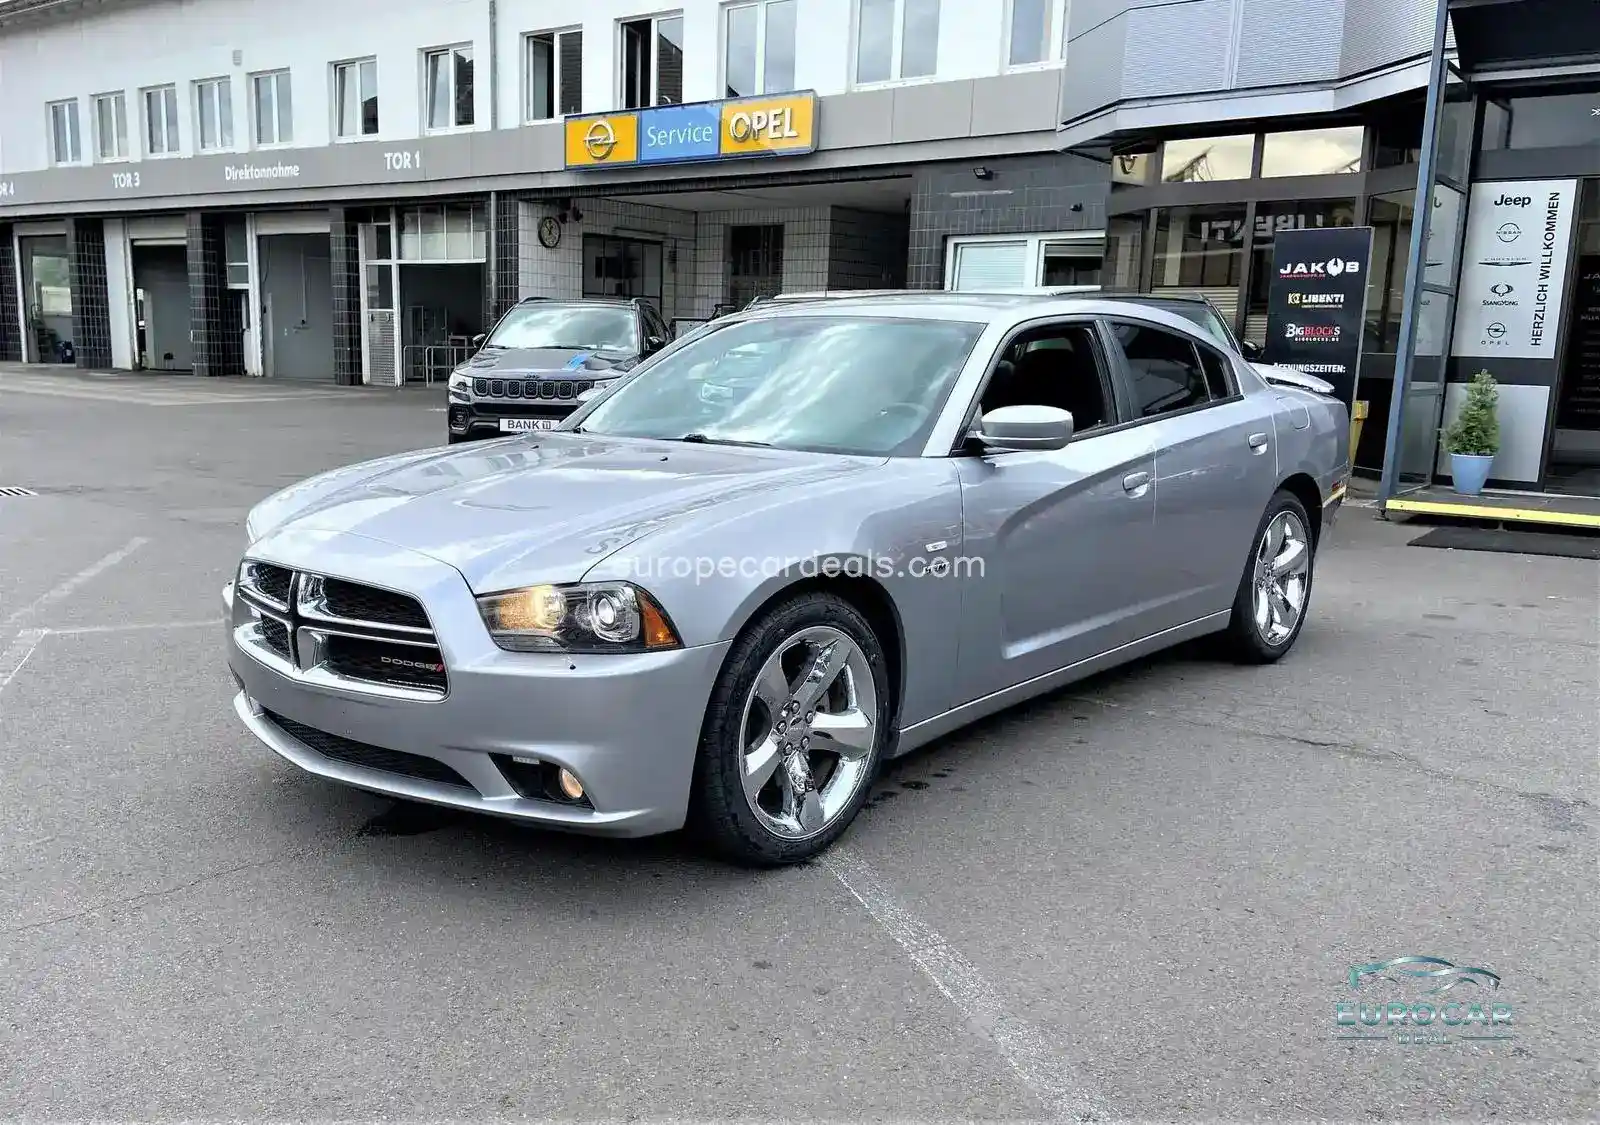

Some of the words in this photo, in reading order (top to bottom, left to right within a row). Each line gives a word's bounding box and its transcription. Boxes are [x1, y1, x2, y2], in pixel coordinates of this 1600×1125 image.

[646, 121, 713, 147] Service
[729, 106, 798, 142] OPEL
[384, 151, 411, 170] TOR
[415, 150, 420, 168] 1
[112, 172, 133, 188] TOR
[133, 171, 140, 187] 3
[224, 160, 300, 181] Direktannahme
[9, 181, 14, 195] 4
[1493, 194, 1532, 208] Jeep
[1538, 191, 1560, 281] WILLKOMMEN
[1279, 257, 1360, 277] JAKOB
[1302, 293, 1345, 303] LIBENTI
[1530, 284, 1549, 346] HERZLICH
[507, 419, 540, 430] BANK
[380, 656, 436, 671] DODGE
